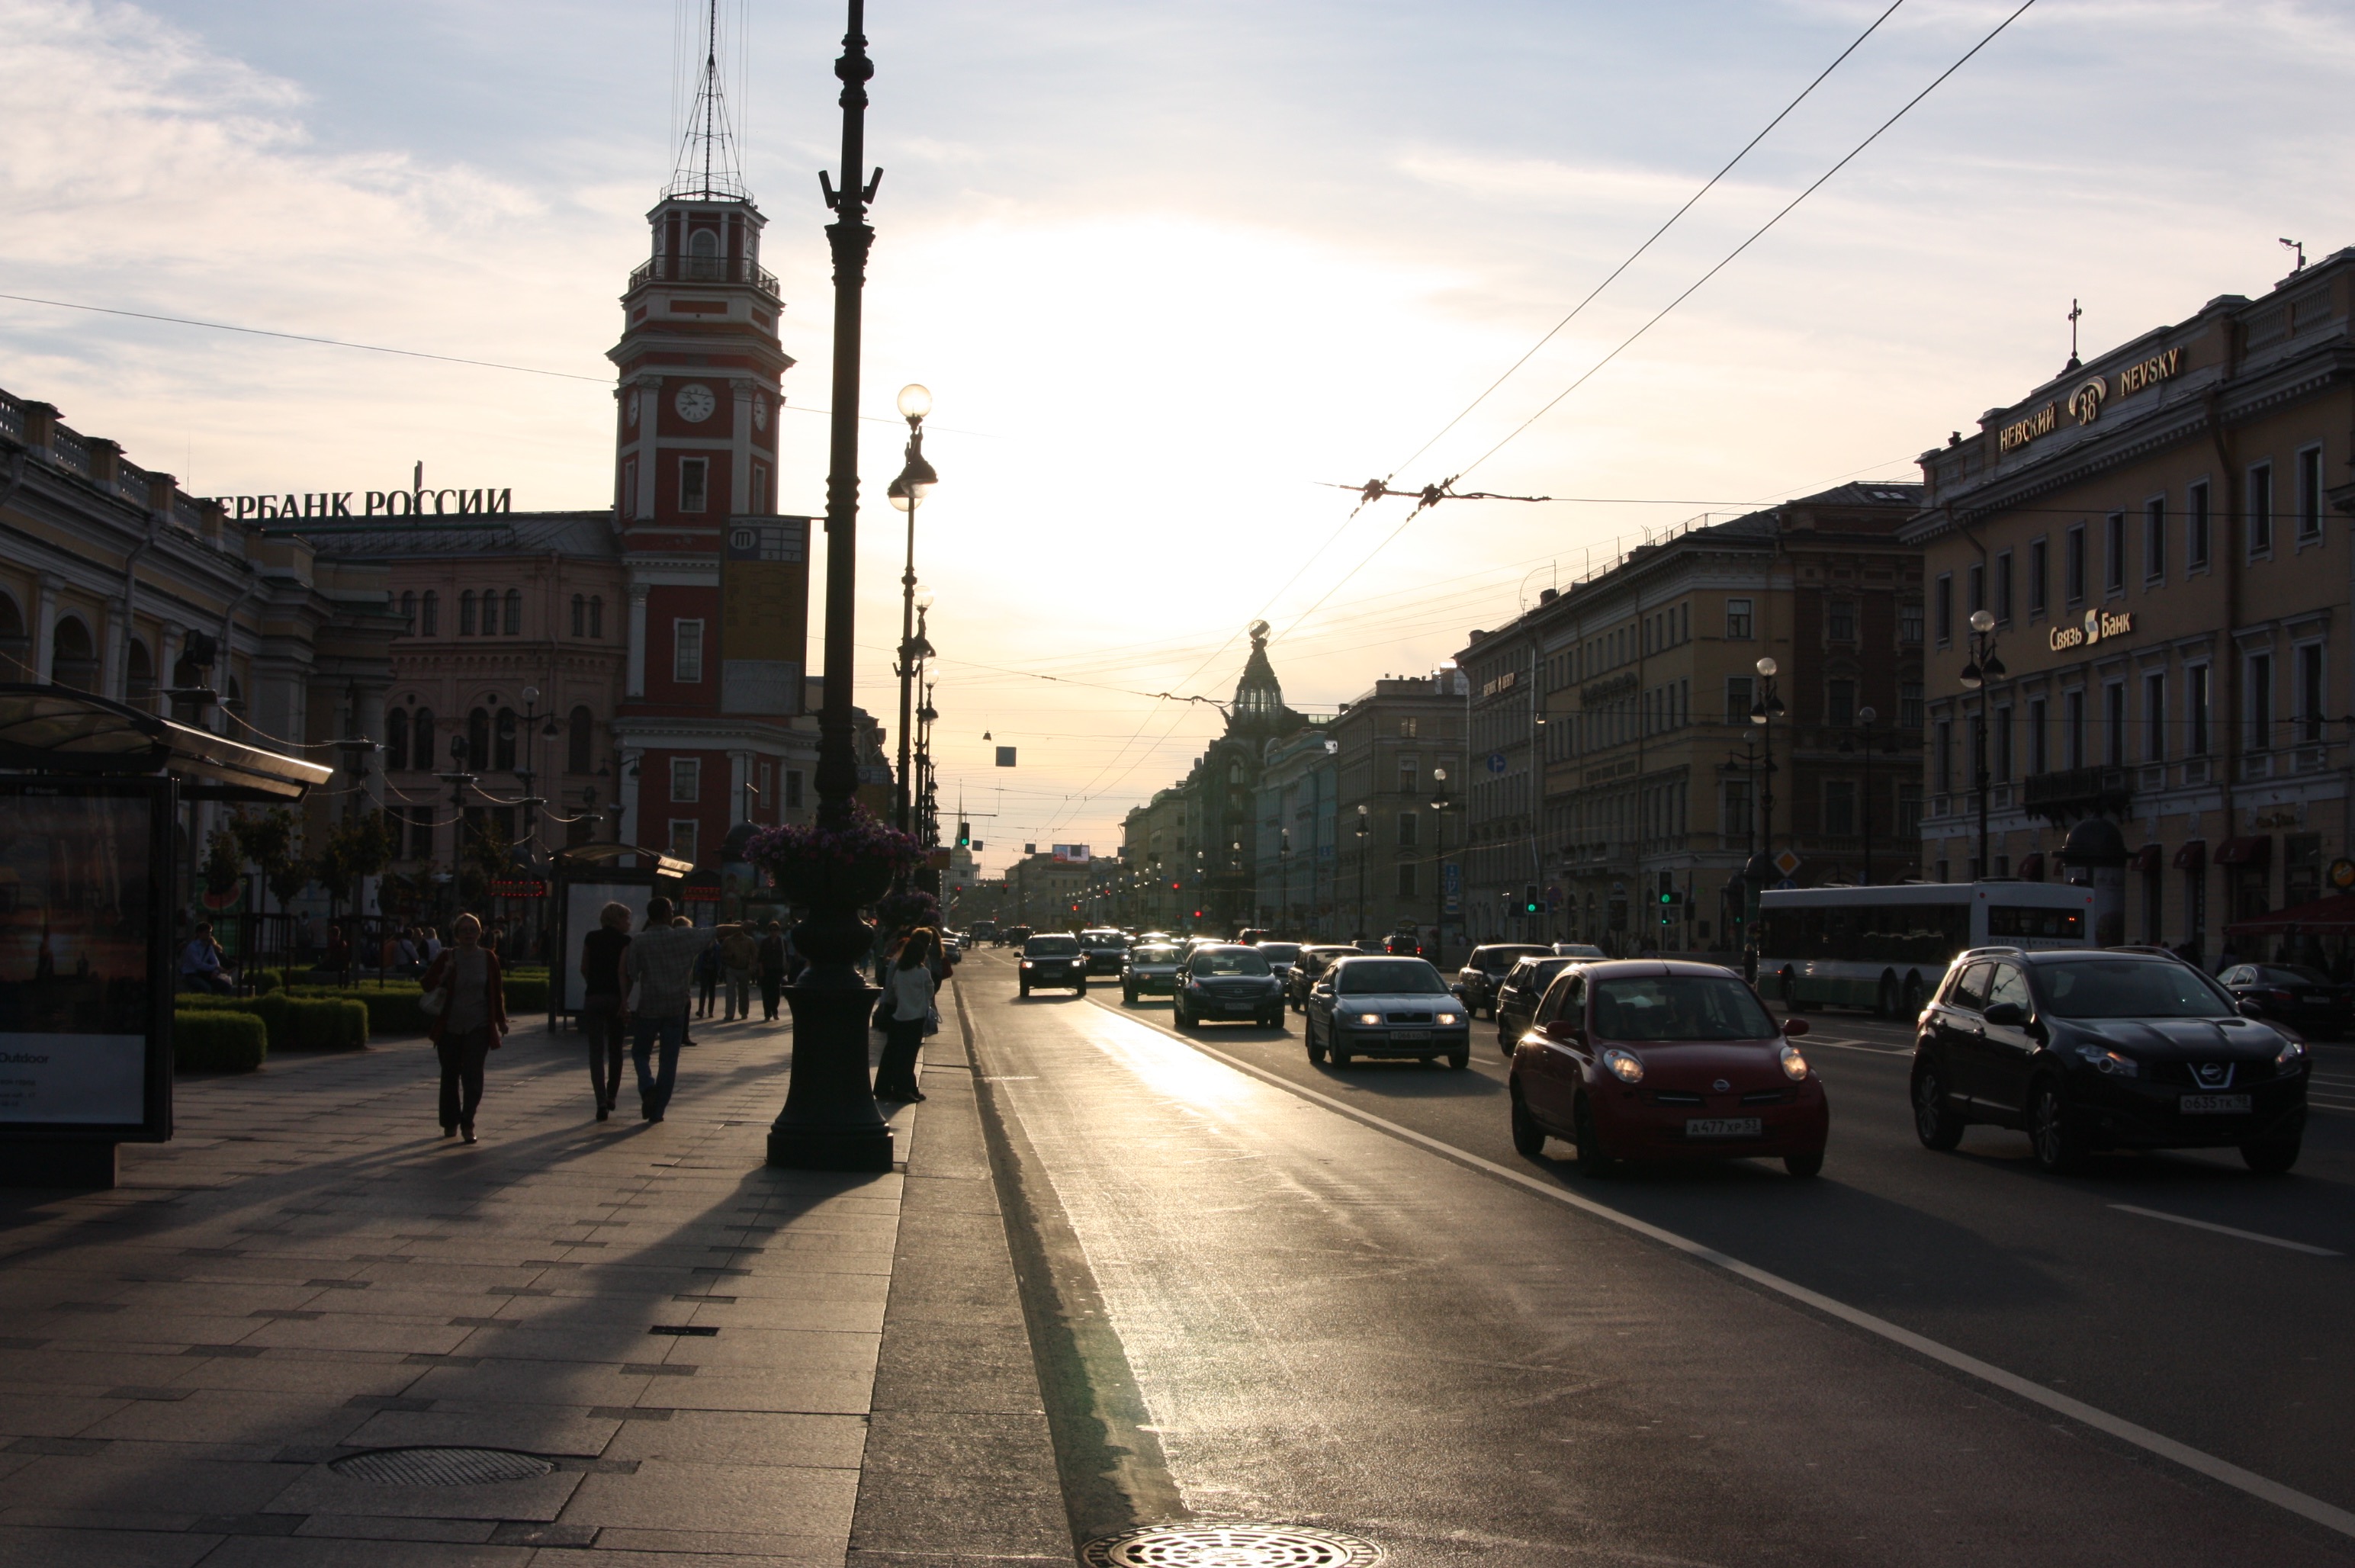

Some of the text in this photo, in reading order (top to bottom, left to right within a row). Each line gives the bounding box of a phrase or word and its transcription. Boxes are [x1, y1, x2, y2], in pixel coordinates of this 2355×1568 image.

[2122, 347, 2180, 397] NEVSKY
[2000, 401, 2056, 452] НЕВСКИЙ
[2079, 389, 2098, 426] 38
[194, 488, 512, 522] ЕРБАНК РОССИИ
[2050, 612, 2131, 651] Связь Банк
